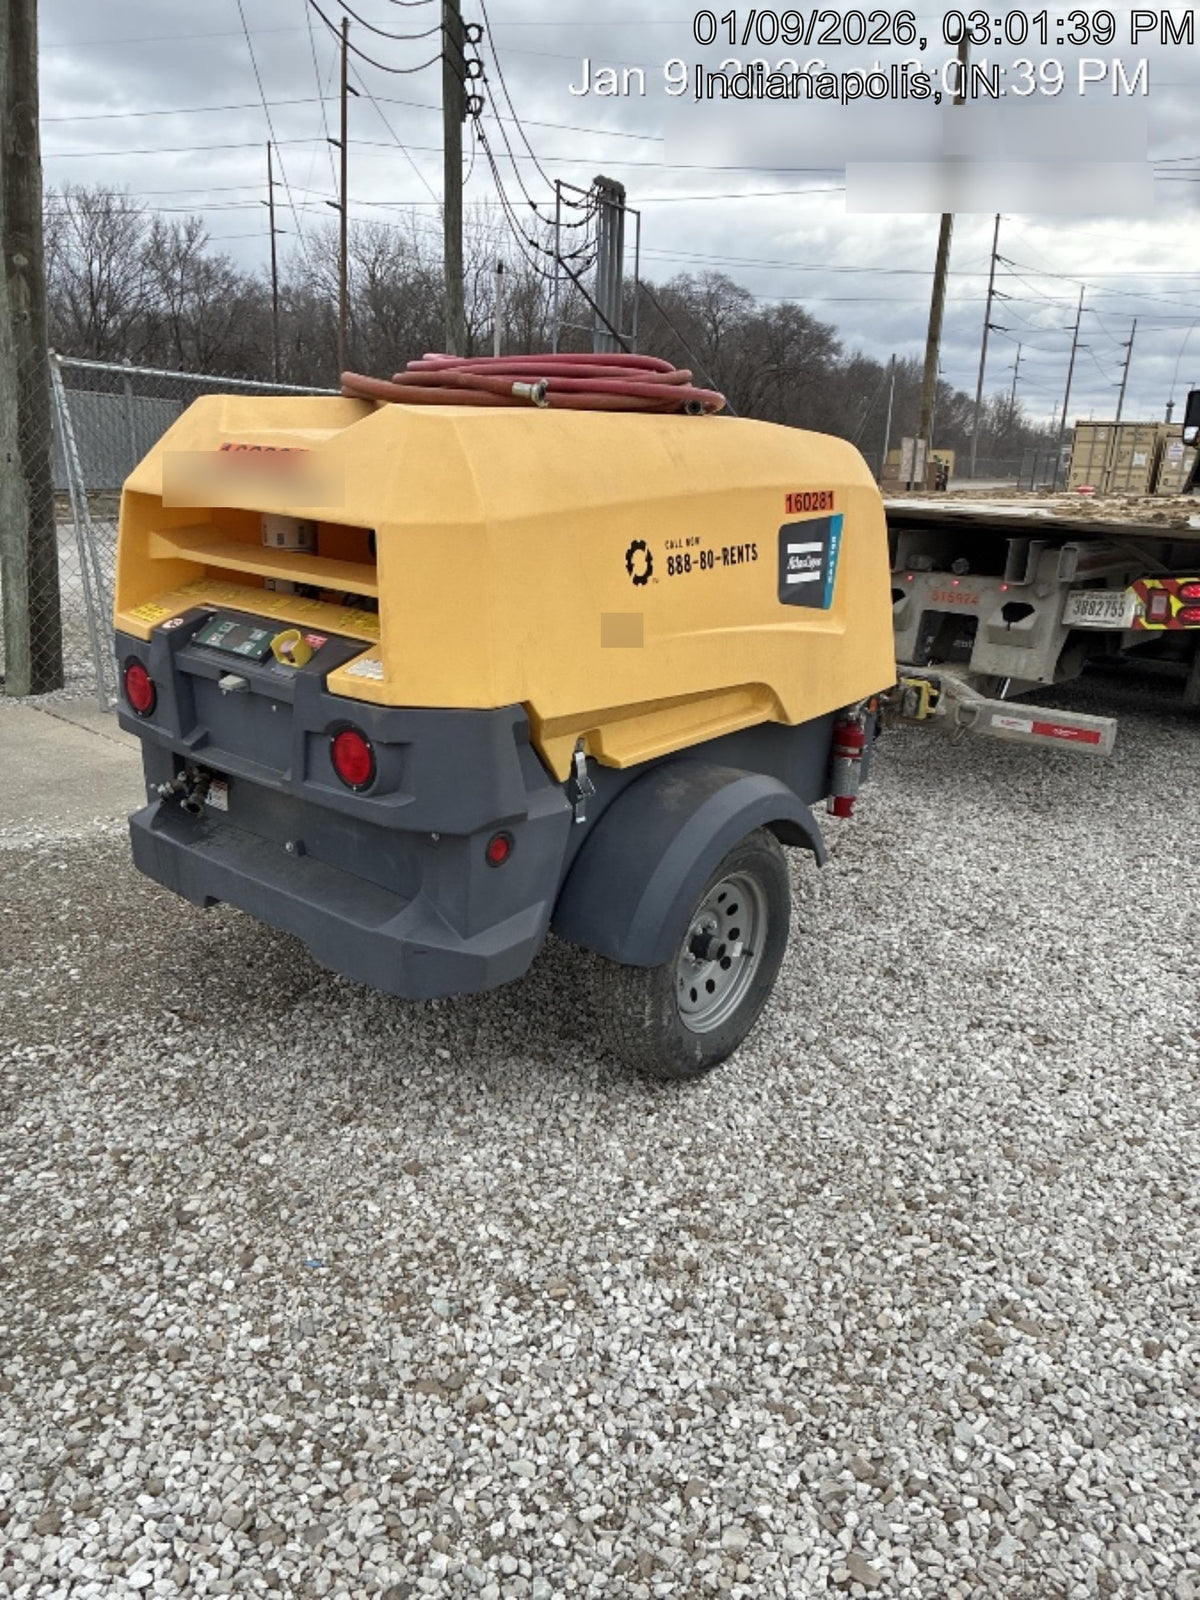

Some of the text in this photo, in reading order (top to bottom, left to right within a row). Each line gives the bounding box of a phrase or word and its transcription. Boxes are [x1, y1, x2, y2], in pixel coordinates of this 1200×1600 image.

[785, 490, 834, 513] 160281
[665, 536, 700, 550] CALL NOW
[666, 543, 758, 577] 888-80-RENTS
[1072, 599, 1127, 618] 3882755
